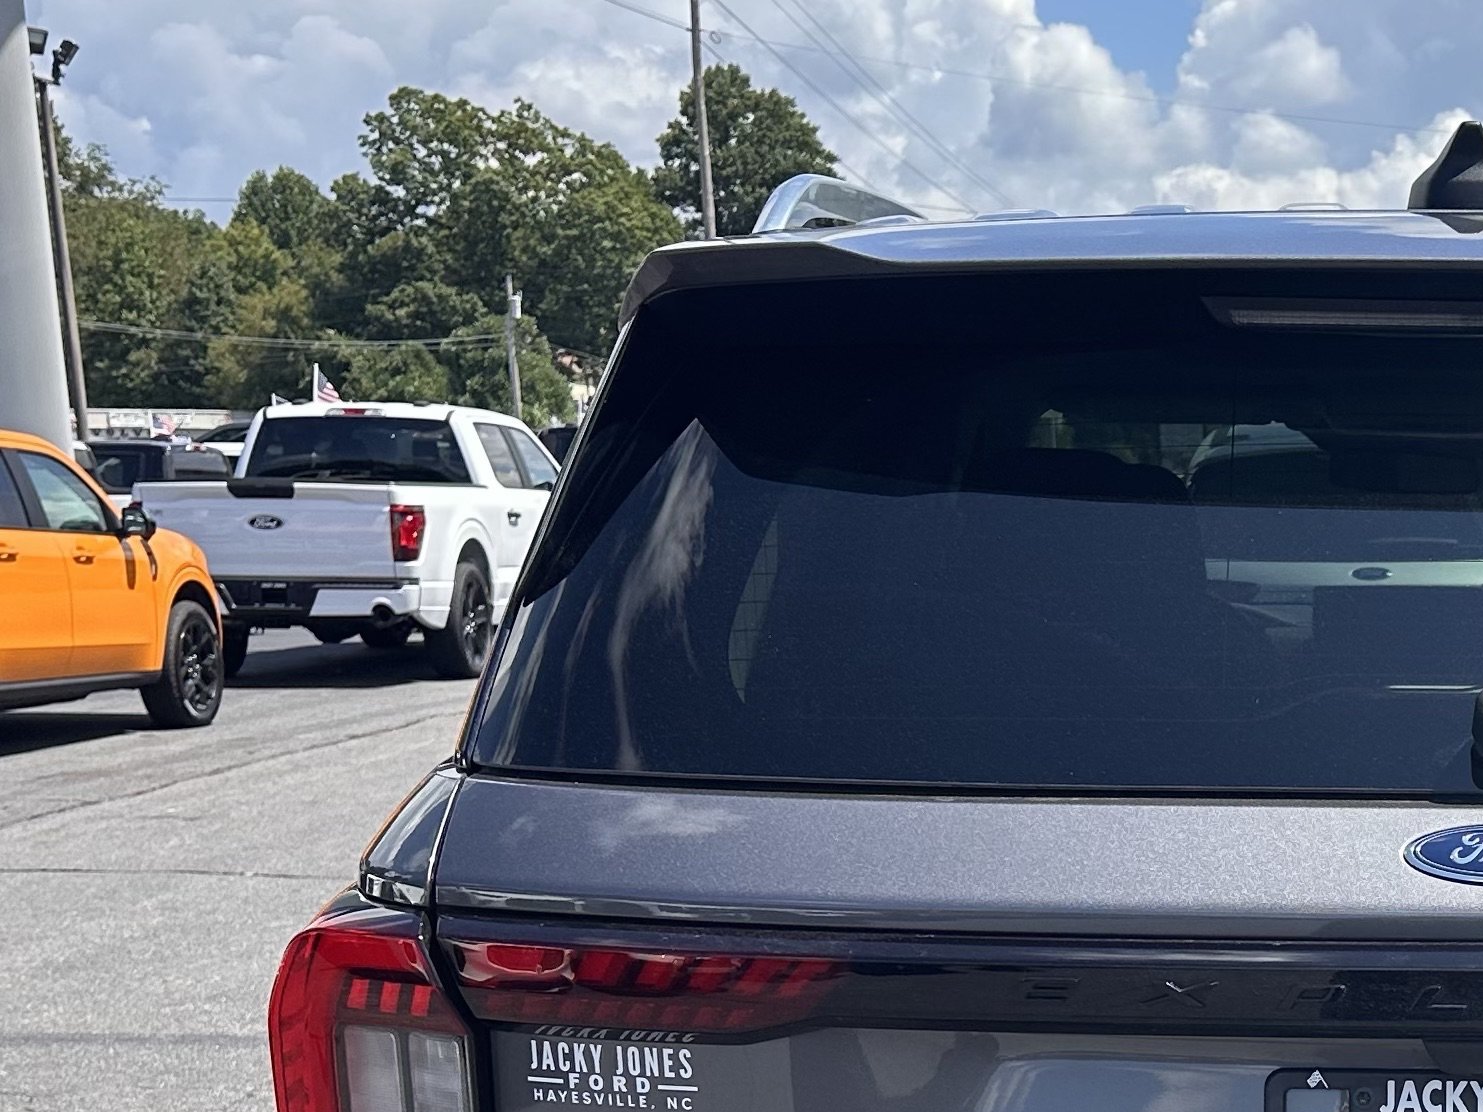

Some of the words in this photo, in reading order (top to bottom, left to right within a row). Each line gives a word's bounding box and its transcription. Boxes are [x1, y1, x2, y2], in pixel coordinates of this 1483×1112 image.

[530, 1040, 602, 1073] JACKY
[616, 1045, 693, 1079] JONES
[568, 1073, 651, 1093] FORD
[533, 1088, 656, 1110] HAYESVILLE,
[666, 1096, 693, 1110] NC
